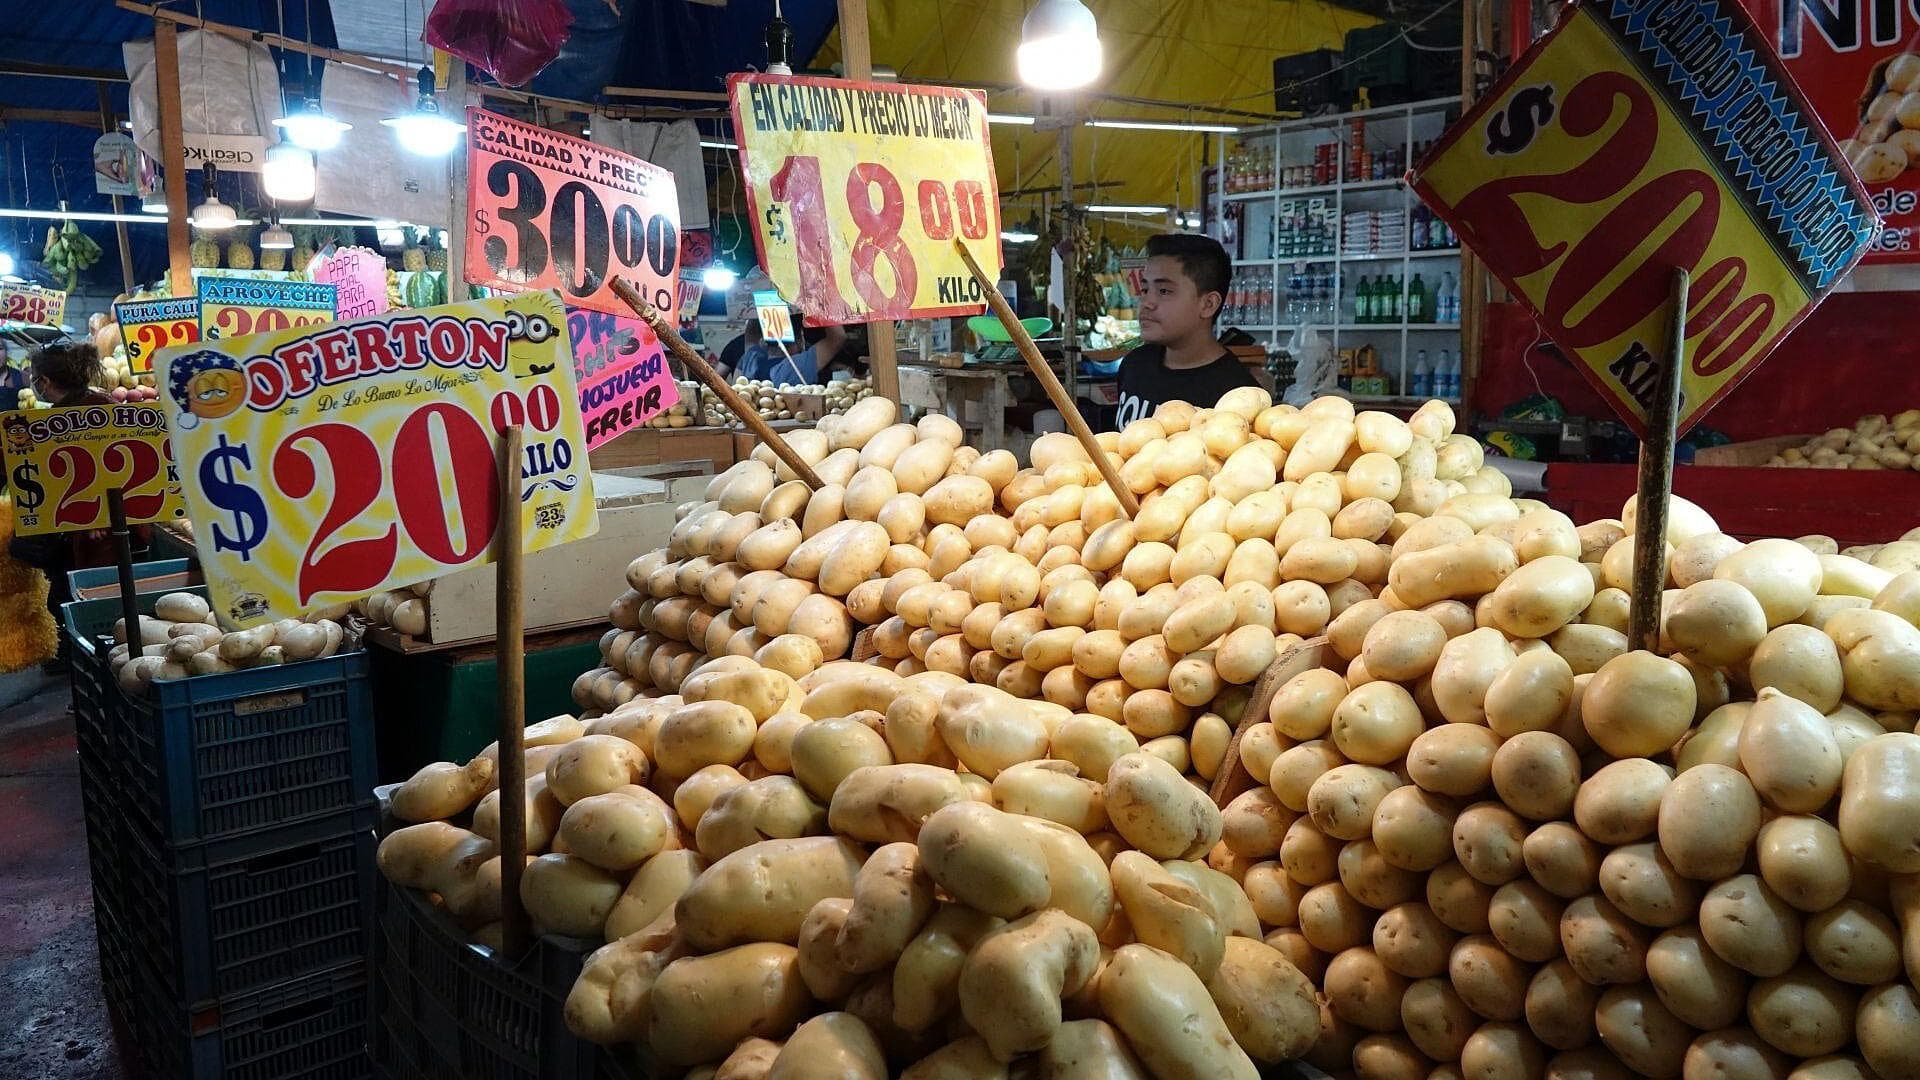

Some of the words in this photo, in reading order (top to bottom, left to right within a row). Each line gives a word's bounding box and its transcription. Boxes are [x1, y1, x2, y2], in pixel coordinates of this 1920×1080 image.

[1645, 0, 1742, 101] CALIDAD
[1779, 0, 1920, 59] NI
[751, 83, 778, 132] EN
[778, 84, 845, 132] CALIDAD
[845, 90, 857, 133] Y
[859, 90, 909, 136] PRECIO
[907, 94, 929, 138] LO
[929, 95, 974, 140] MEJOR
[1484, 84, 1555, 155] $
[1715, 75, 1756, 118] Y
[479, 125, 573, 164] CALIDAD
[579, 154, 593, 169] Y
[1727, 92, 1801, 185] PRECIO
[1453, 71, 1721, 348] 20
[1773, 161, 1819, 210] LO
[474, 208, 490, 236] $
[484, 159, 610, 298] 30
[613, 204, 677, 277] 00
[769, 156, 918, 319] 18
[917, 179, 988, 241] 00
[1792, 188, 1857, 271] MEJOR
[206, 284, 329, 303] APROVECHE
[328, 254, 360, 280] PAPA
[937, 276, 981, 304] KILO
[8, 294, 46, 323] 28
[122, 306, 160, 319] PURA
[163, 303, 198, 316] CALI
[336, 284, 366, 309] PARA
[129, 341, 141, 358] $
[245, 317, 510, 410] OFERTON
[316, 394, 338, 412] De
[342, 391, 360, 408] Lo
[364, 385, 401, 403] Bueno
[405, 380, 422, 396] Lo
[586, 385, 661, 444] FREIR
[29, 406, 109, 442] SOLO
[12, 459, 45, 513] $
[48, 439, 165, 528] 22
[199, 434, 269, 561] $
[273, 403, 501, 607] 20
[490, 384, 560, 439] 00
[540, 508, 560, 522] 23
